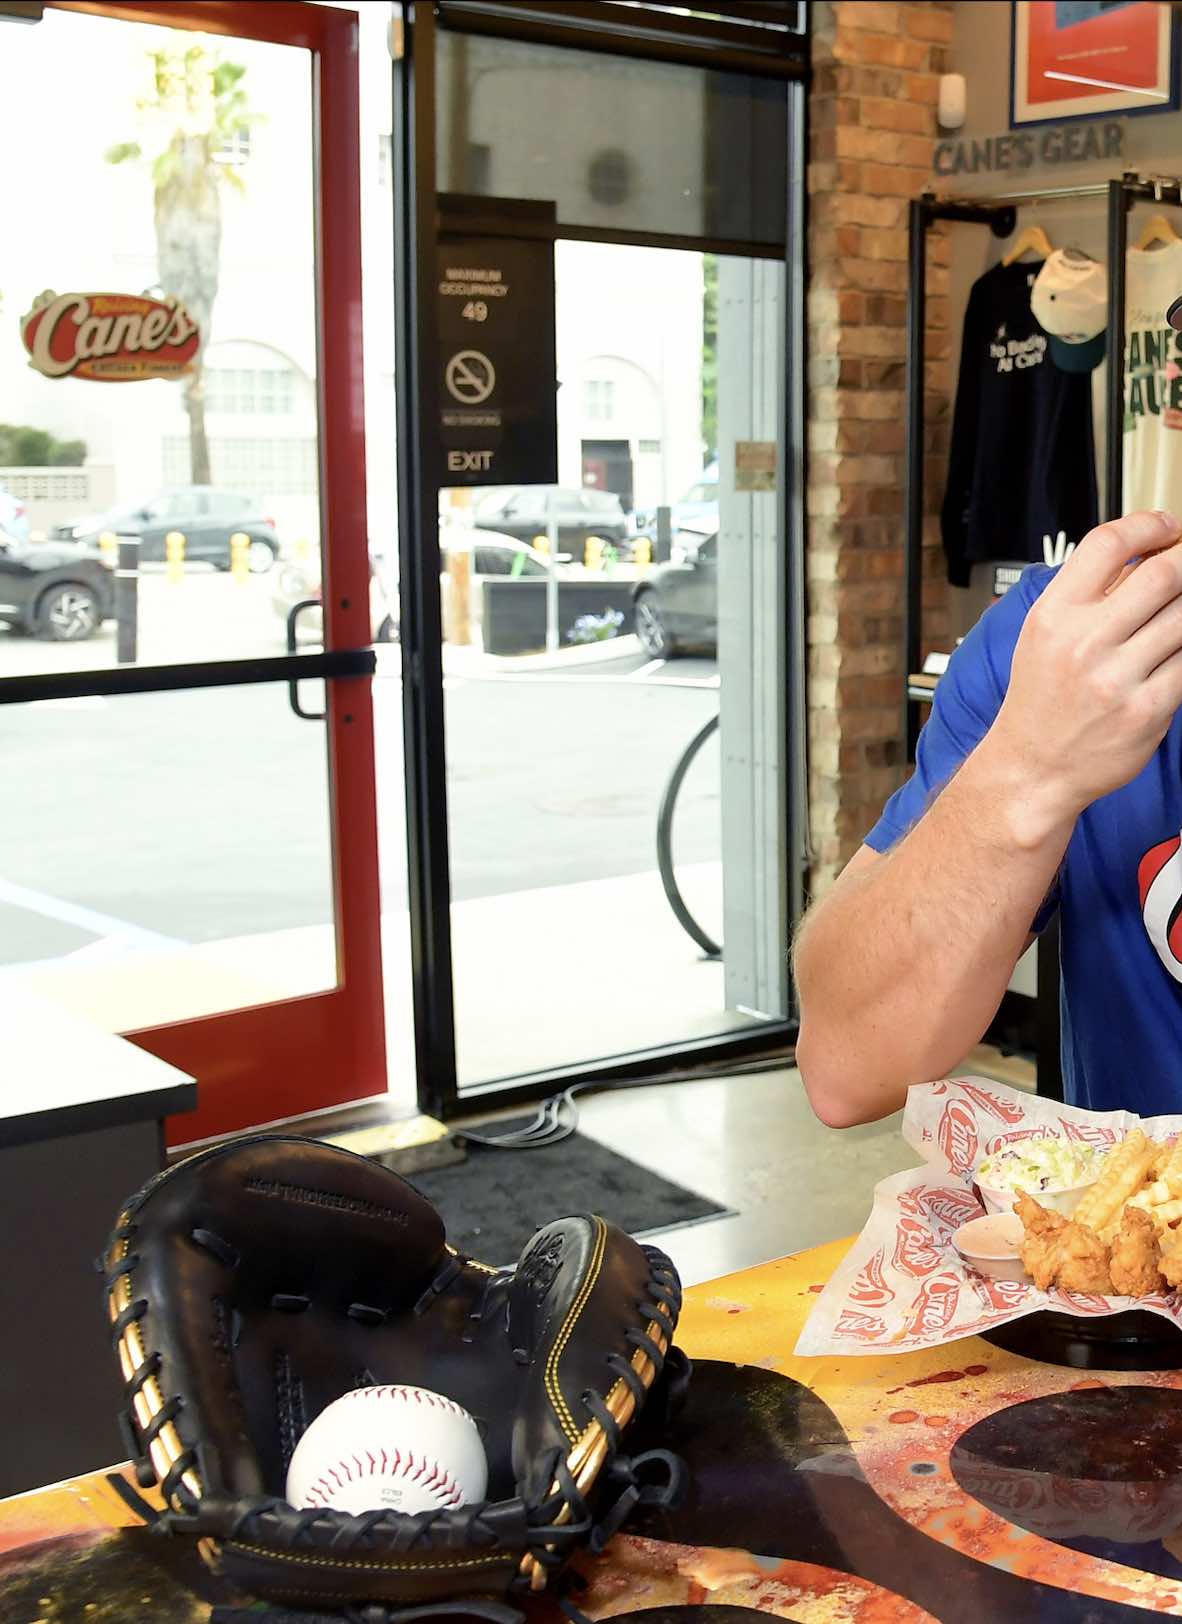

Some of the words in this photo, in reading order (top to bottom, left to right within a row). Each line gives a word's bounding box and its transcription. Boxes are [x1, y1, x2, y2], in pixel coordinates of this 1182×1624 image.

[1041, 123, 1124, 164] GEAR
[461, 301, 488, 322] 49
[448, 450, 495, 471] EXIT
